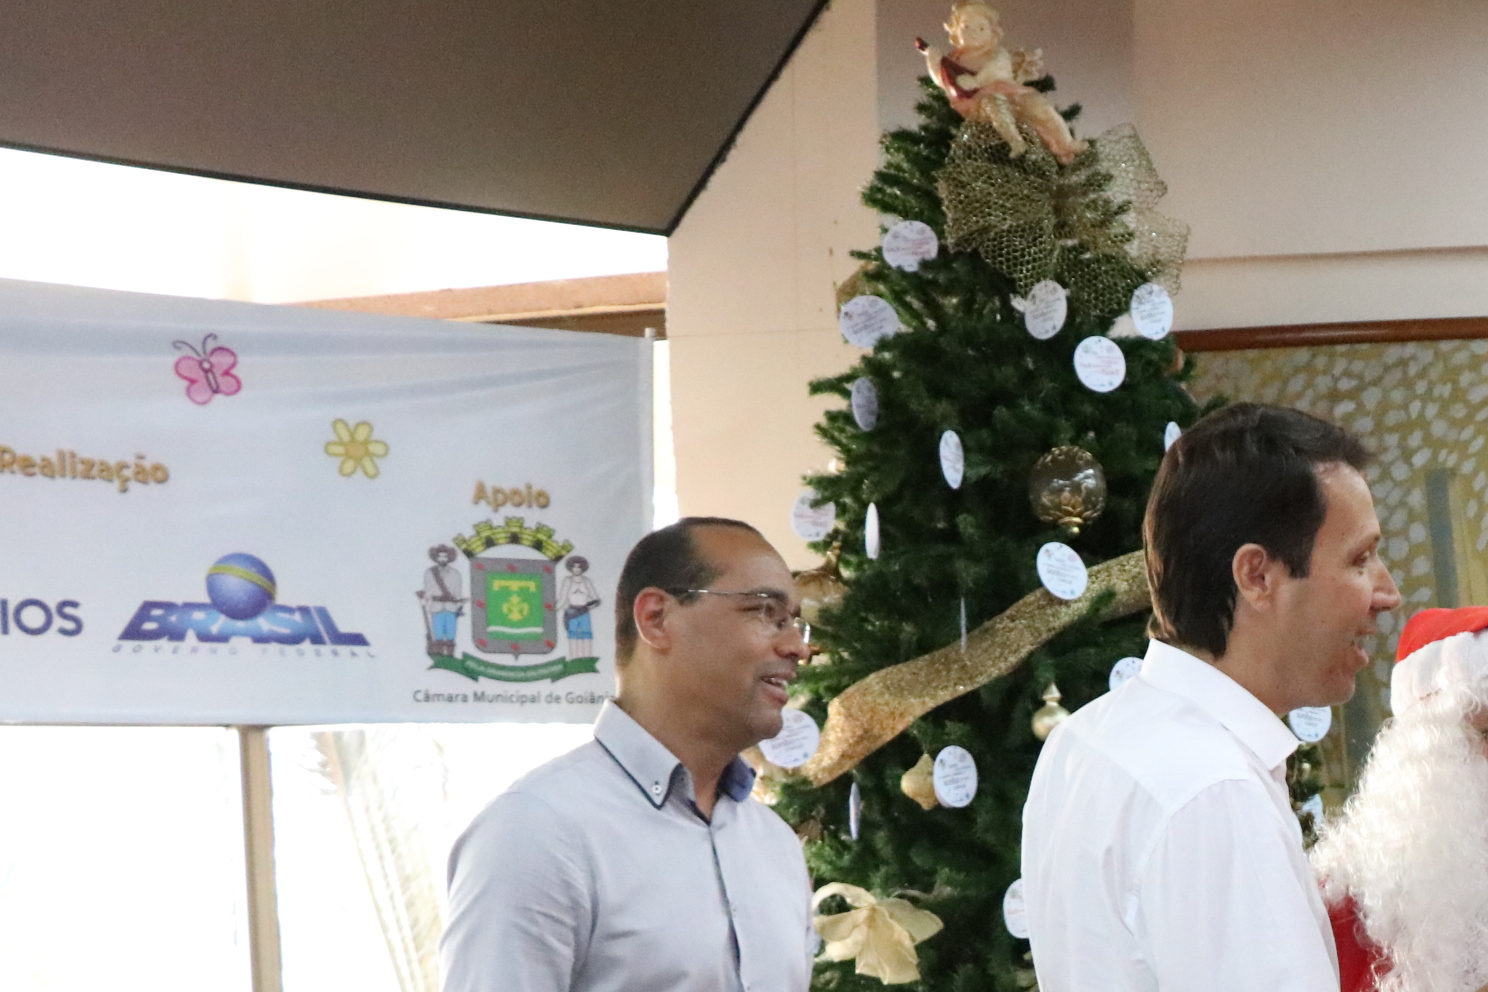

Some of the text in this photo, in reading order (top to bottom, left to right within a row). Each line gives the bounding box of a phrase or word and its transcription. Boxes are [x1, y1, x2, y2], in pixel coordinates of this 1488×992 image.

[0, 445, 169, 492] Realização
[473, 481, 550, 511] Apoio
[117, 600, 371, 645] BRASIL
[413, 689, 468, 703] Câmara
[473, 690, 541, 706] Municipal
[545, 690, 561, 704] de
